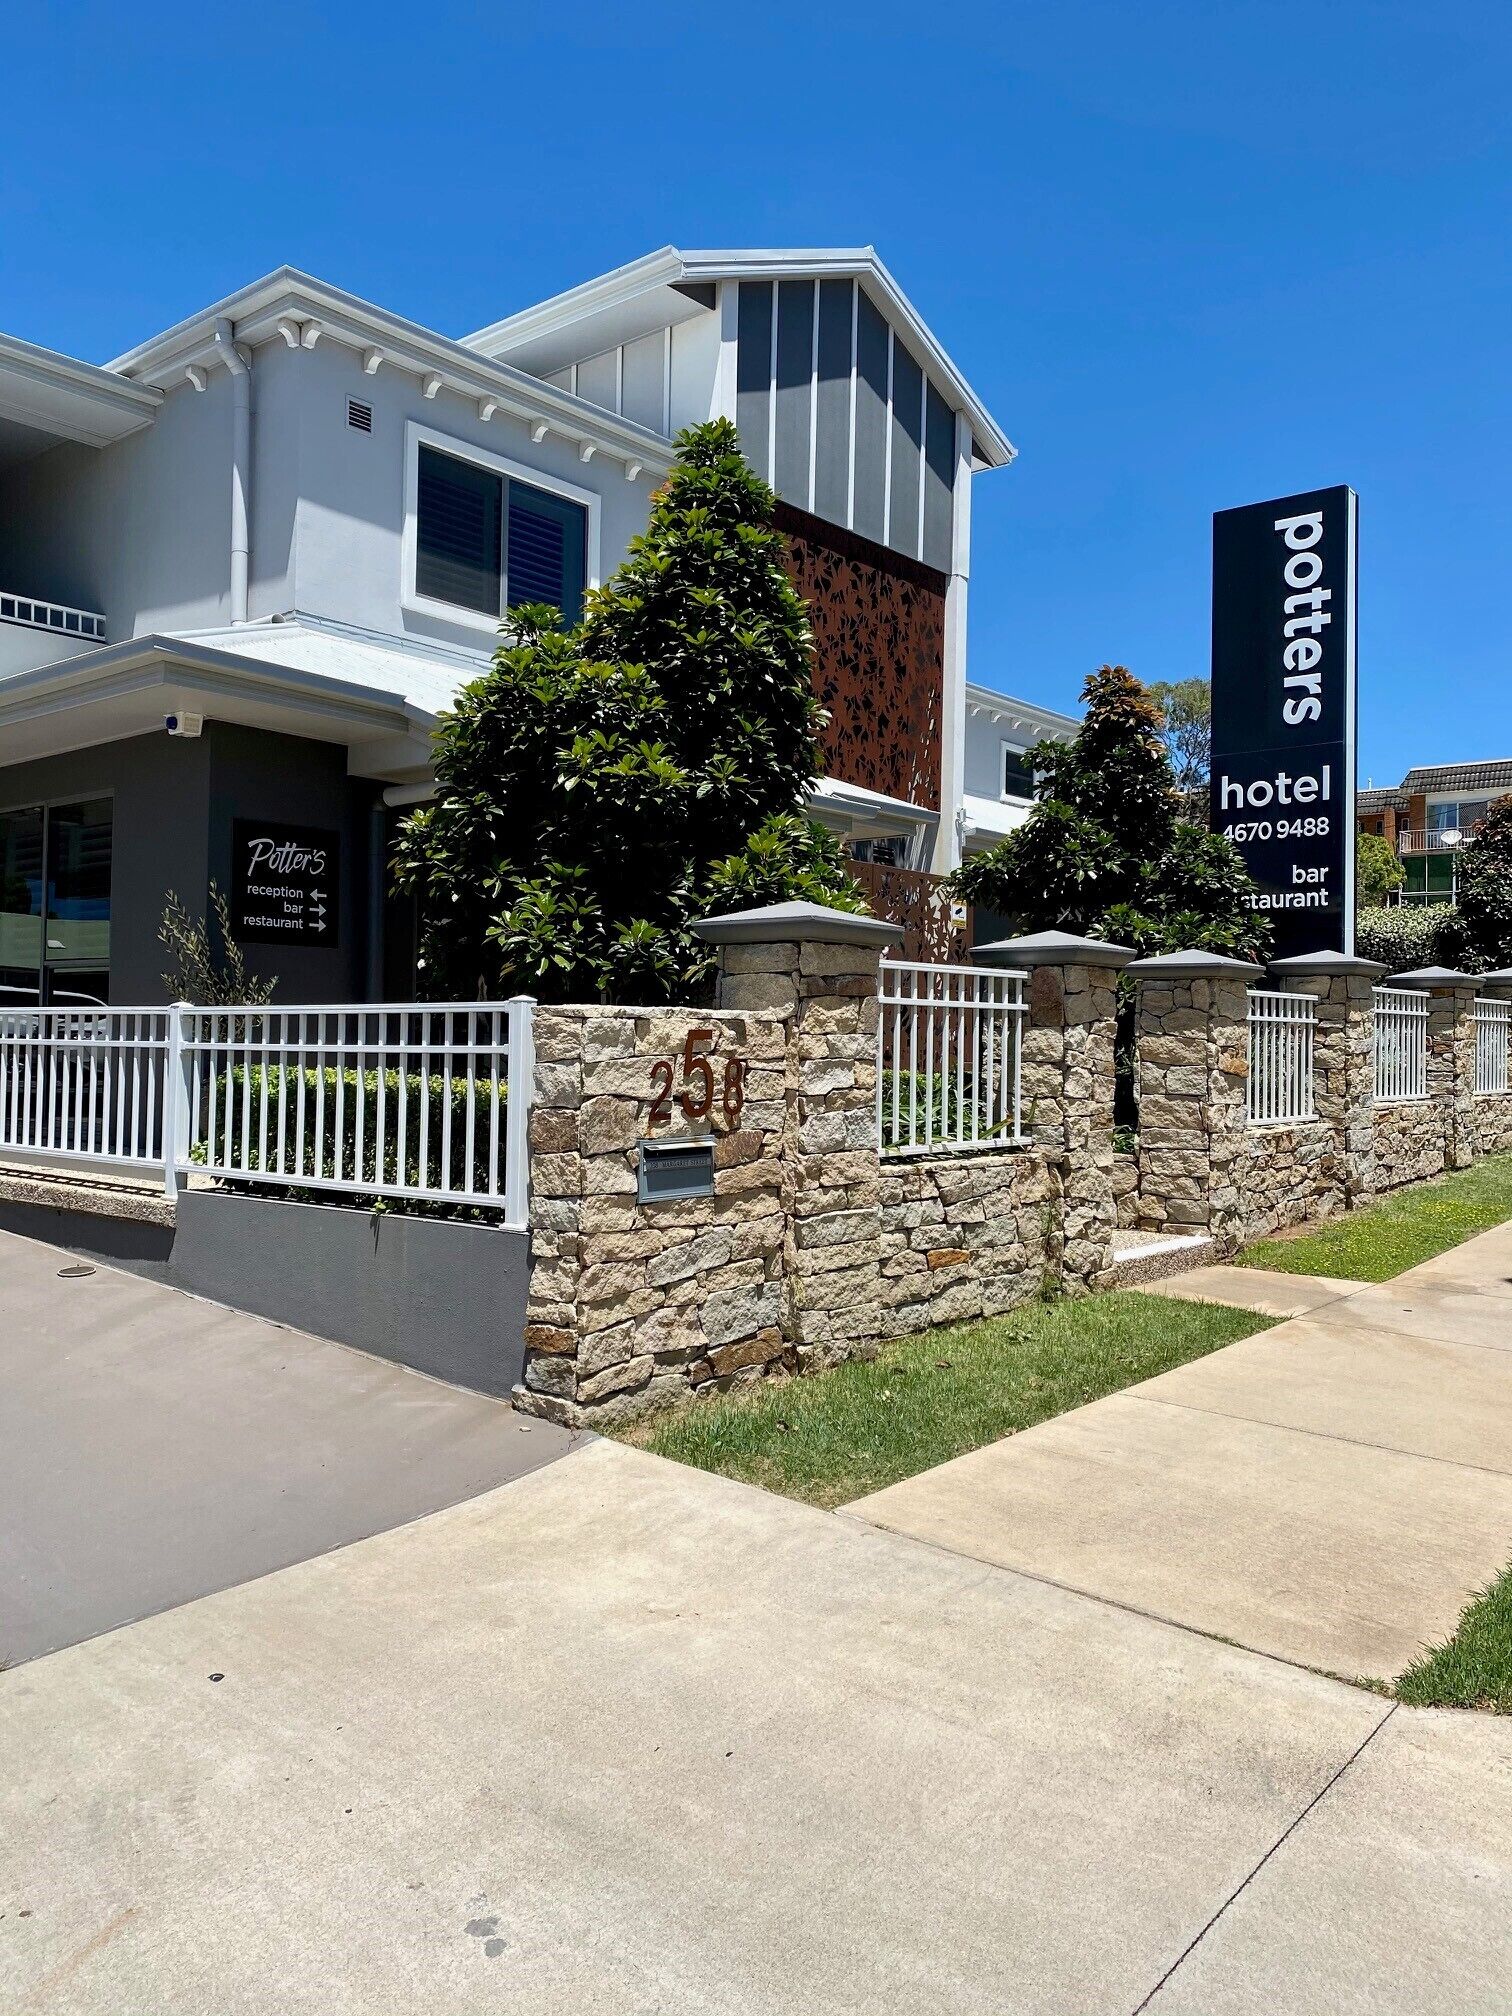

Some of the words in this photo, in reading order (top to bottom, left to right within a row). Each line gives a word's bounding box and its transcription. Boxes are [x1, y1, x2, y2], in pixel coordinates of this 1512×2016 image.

[1274, 511, 1332, 725] potters
[1221, 765, 1330, 810] hotel
[1223, 822, 1273, 842] 4670
[1276, 816, 1330, 839] 9488
[247, 838, 326, 876] Potter's
[1292, 864, 1329, 884] bar
[247, 884, 303, 898] reception
[1240, 888, 1329, 910] staurant
[283, 901, 303, 913] bar
[243, 915, 303, 929] restaurant
[649, 1029, 743, 1121] 258
